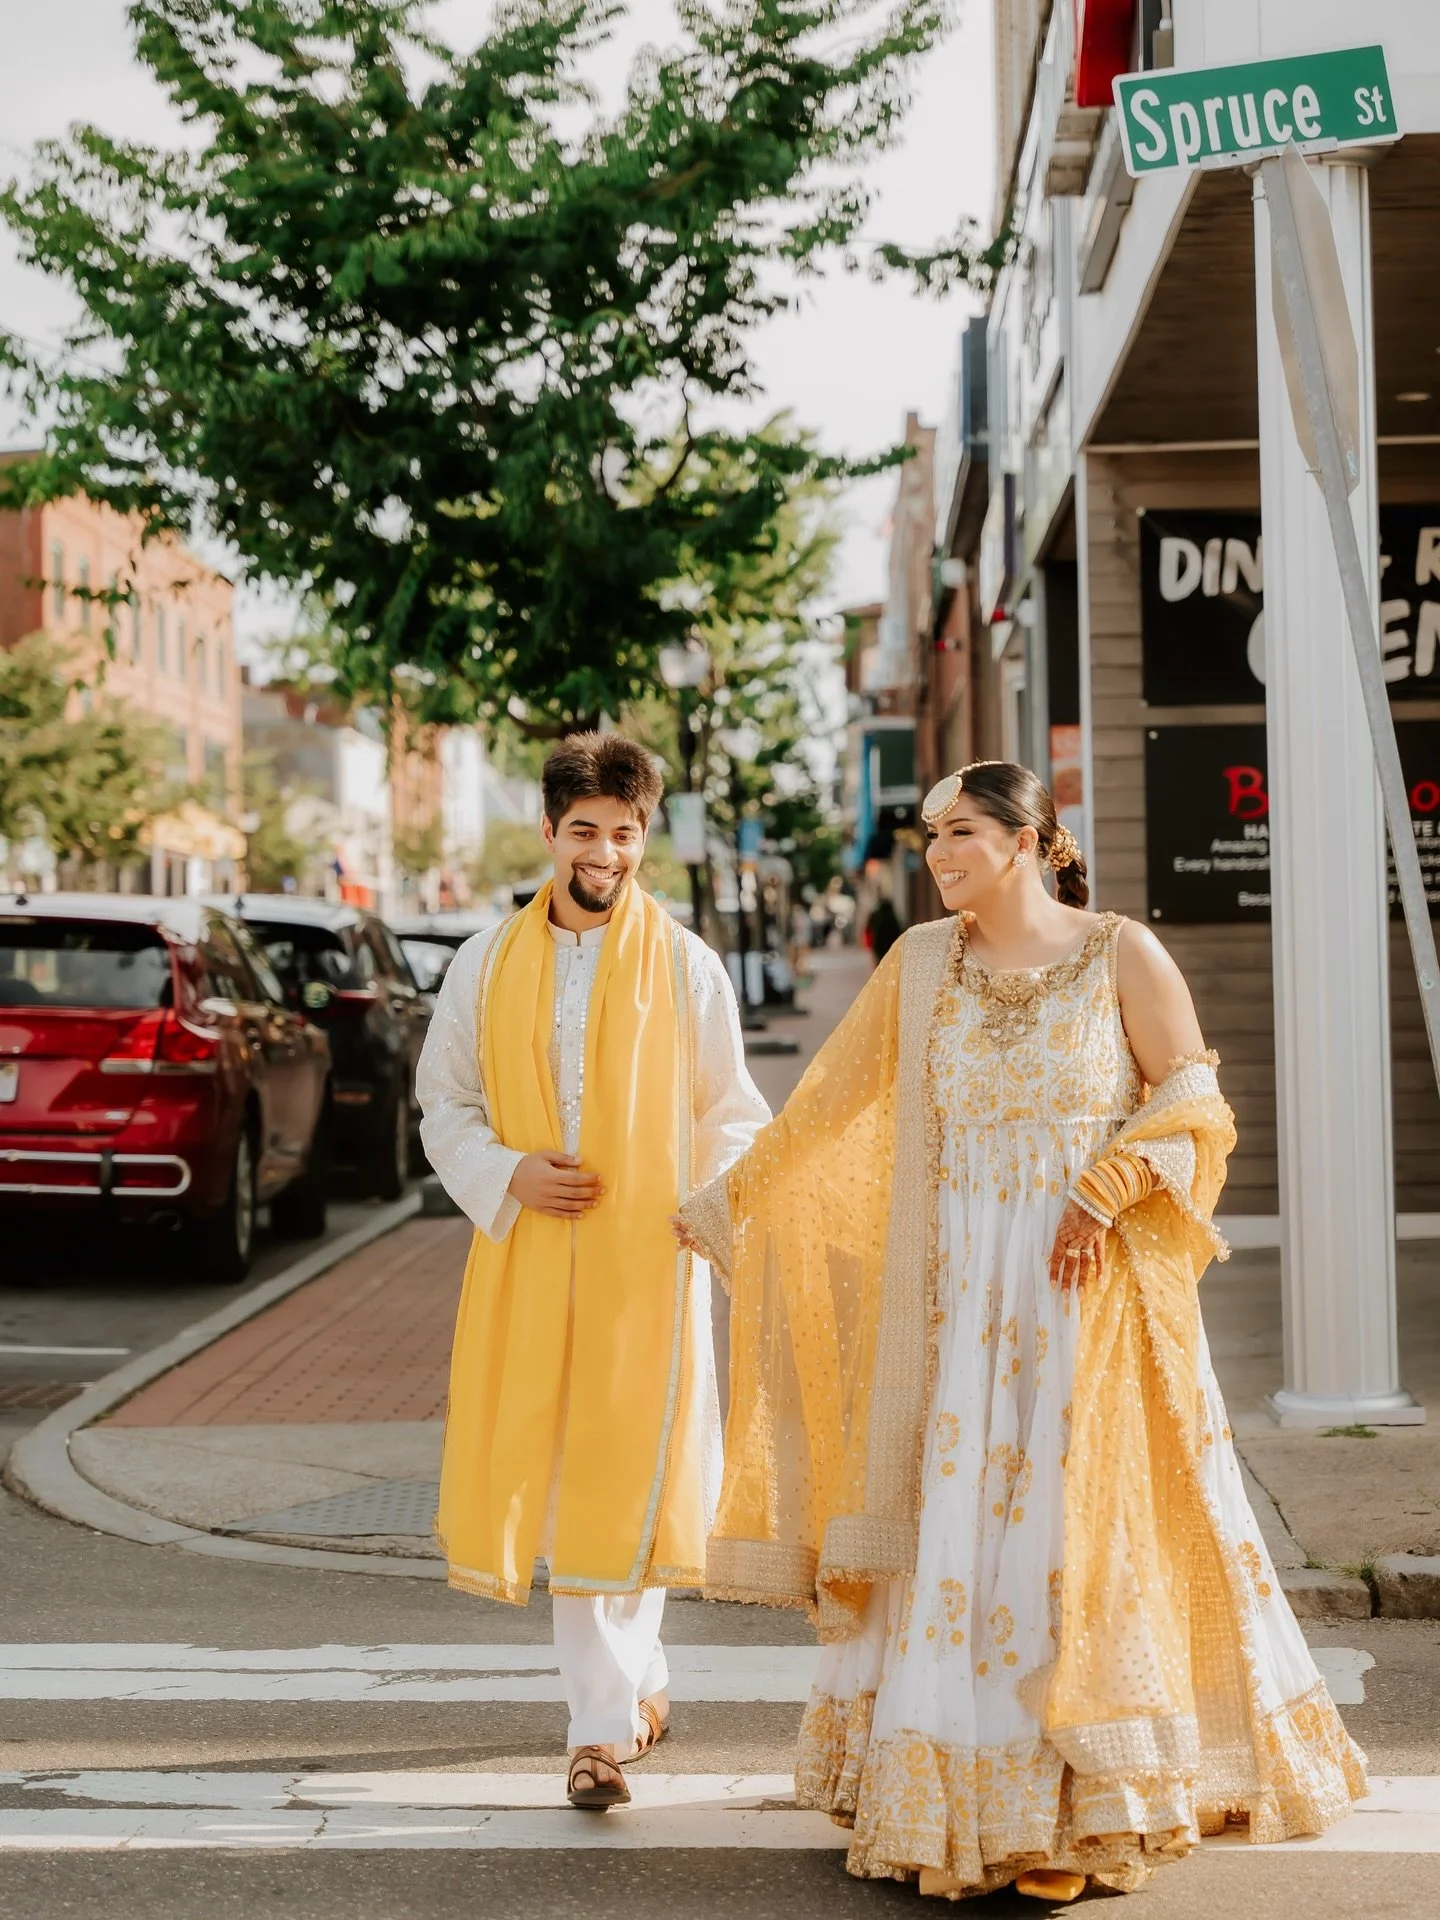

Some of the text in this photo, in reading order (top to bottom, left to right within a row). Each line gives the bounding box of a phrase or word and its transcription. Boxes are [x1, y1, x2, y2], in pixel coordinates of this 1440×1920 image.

[1130, 84, 1387, 166] Spruce St
[1159, 535, 1264, 602] DIN
